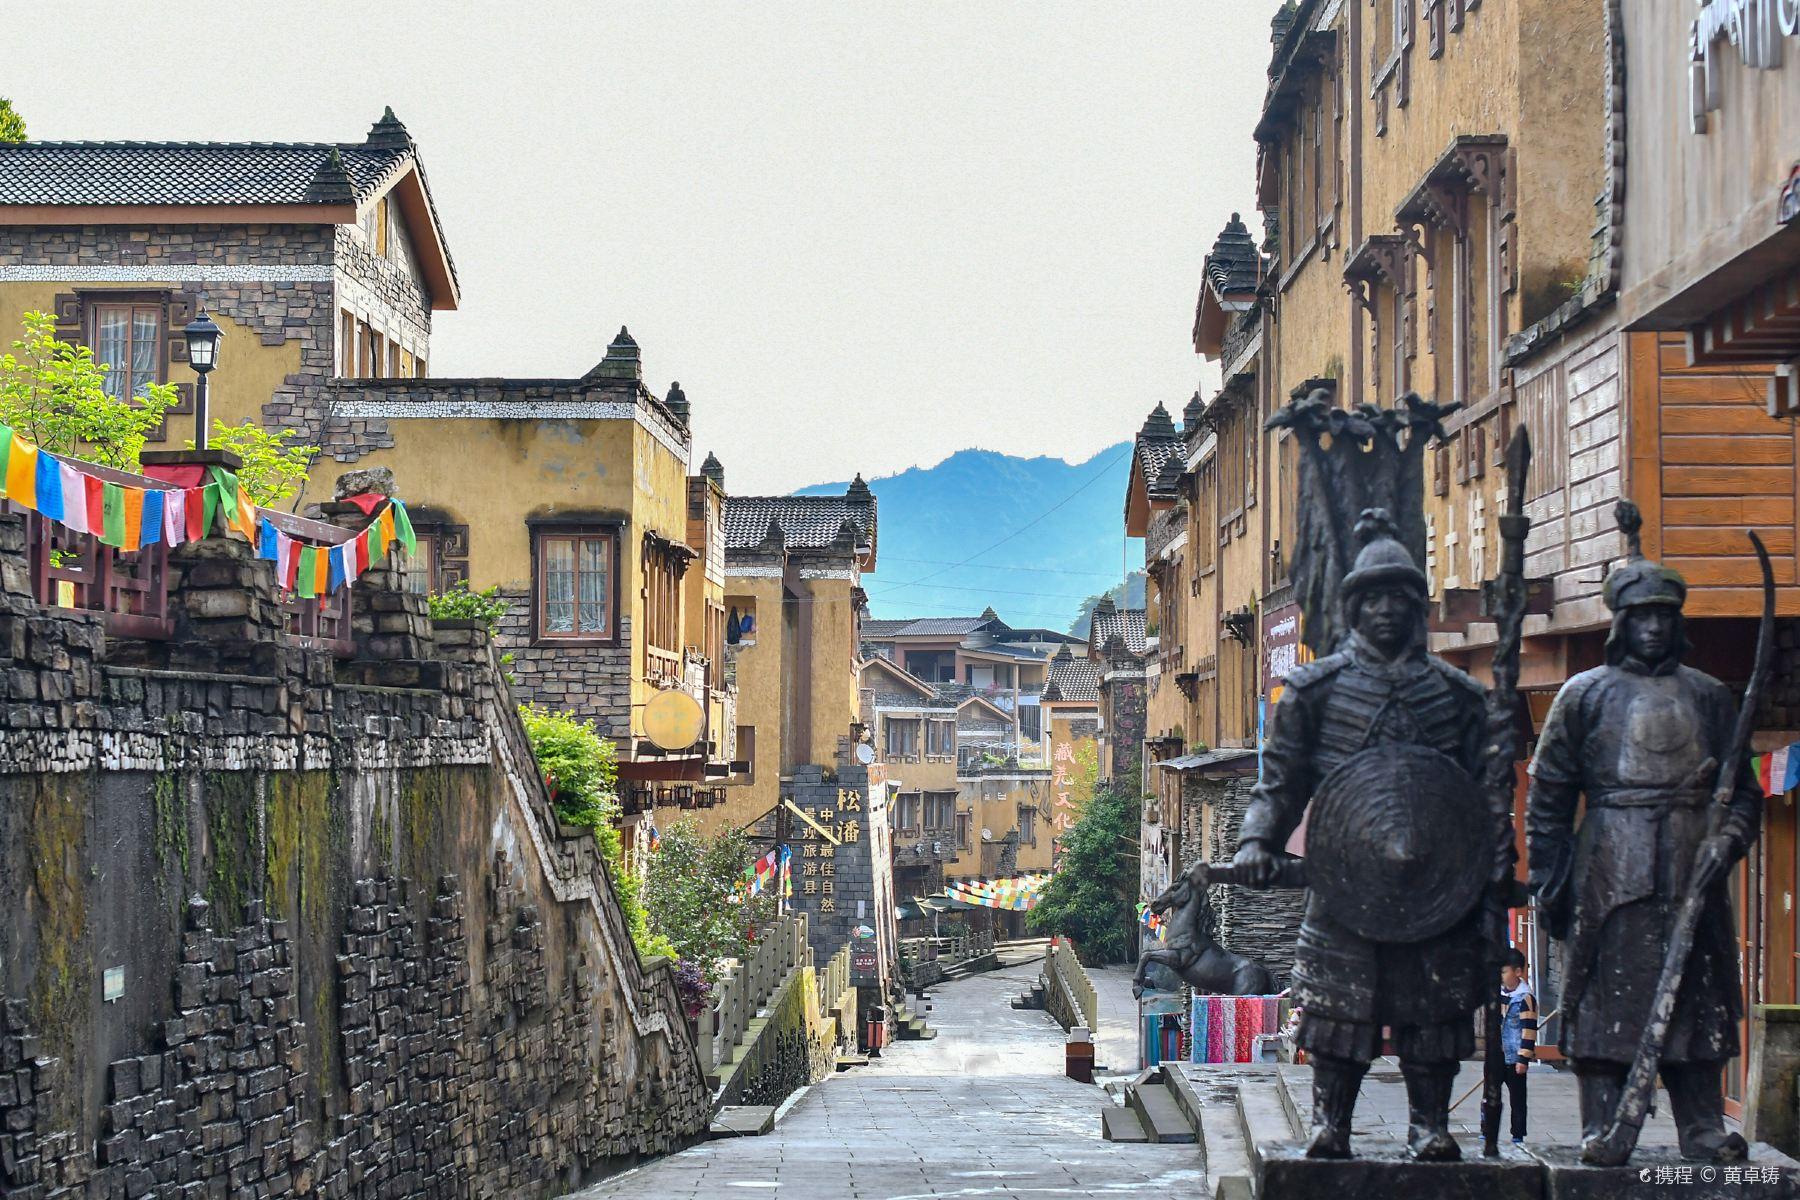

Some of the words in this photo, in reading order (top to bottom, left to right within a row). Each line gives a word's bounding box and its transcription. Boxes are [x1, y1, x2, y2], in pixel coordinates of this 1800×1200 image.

[802, 807, 817, 894] 景观旅游县
[837, 788, 861, 843] 松潘
[820, 807, 835, 912] 中国最佳自然
